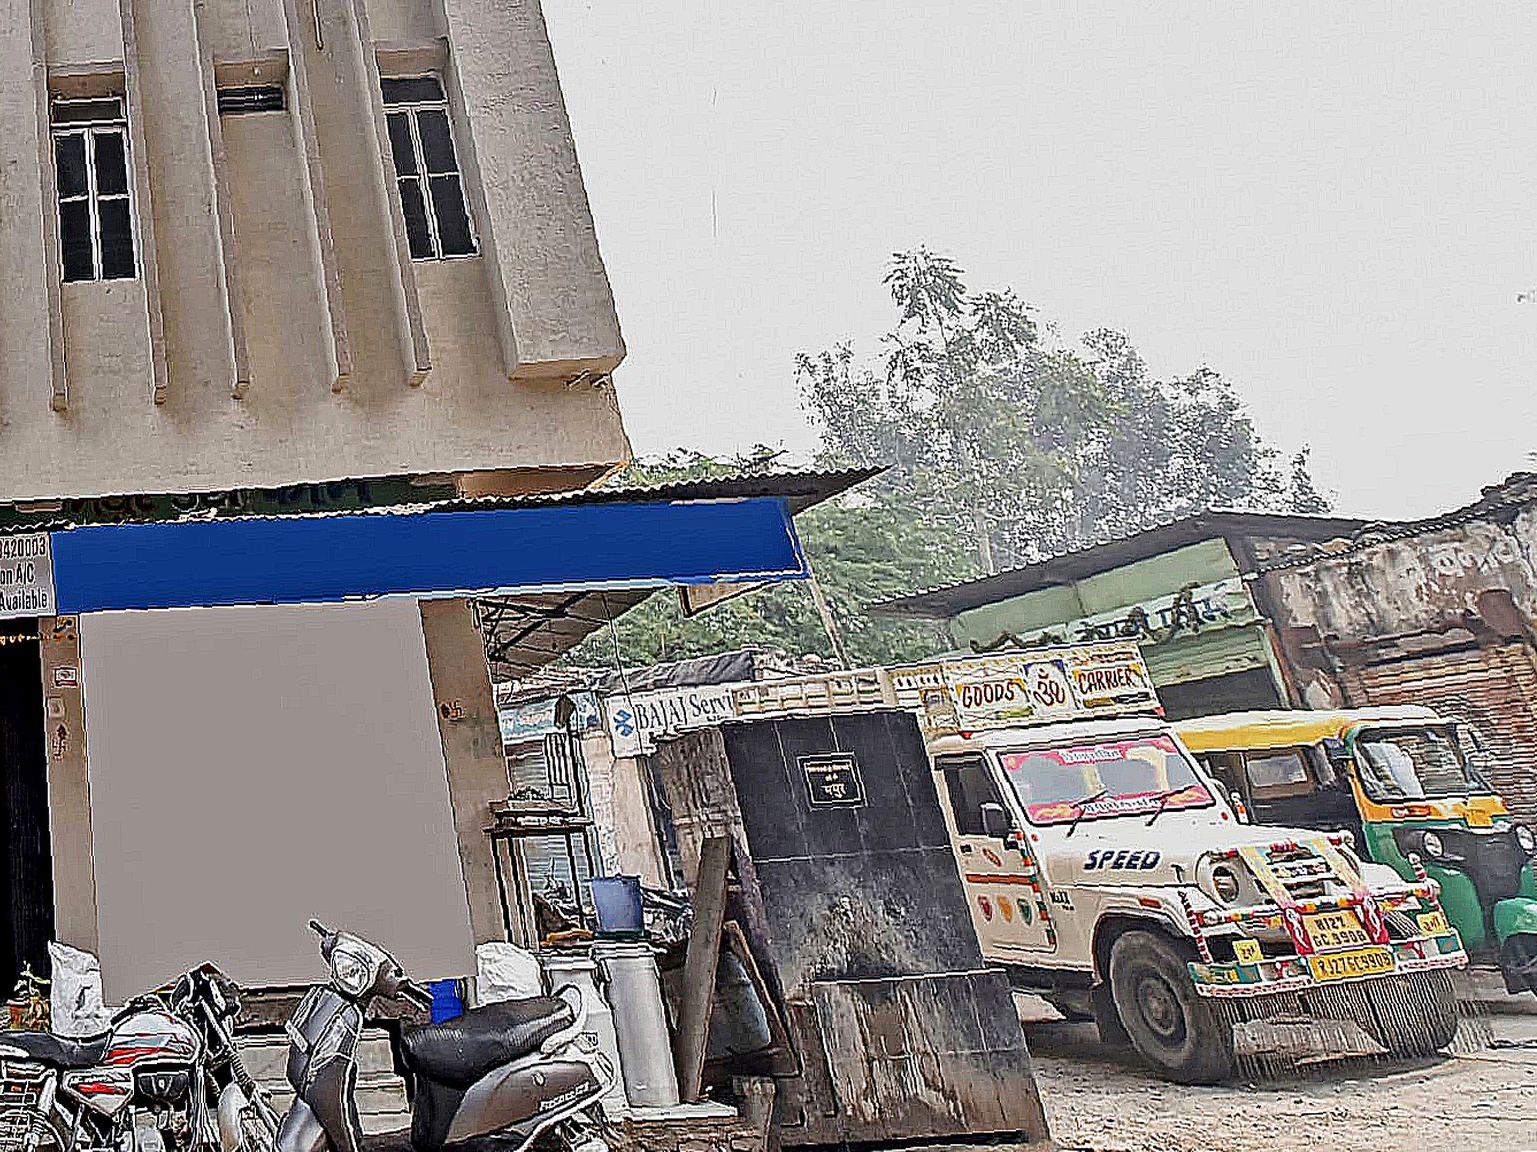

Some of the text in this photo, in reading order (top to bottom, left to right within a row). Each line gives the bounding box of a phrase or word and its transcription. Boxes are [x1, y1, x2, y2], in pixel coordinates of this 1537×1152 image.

[16, 562, 36, 585] A/C
[0, 588, 48, 611] Available
[962, 680, 1016, 709] GOODS
[1077, 667, 1137, 695] CARRIER
[635, 696, 688, 732] BAJAJ
[1083, 849, 1161, 870] SPEED
